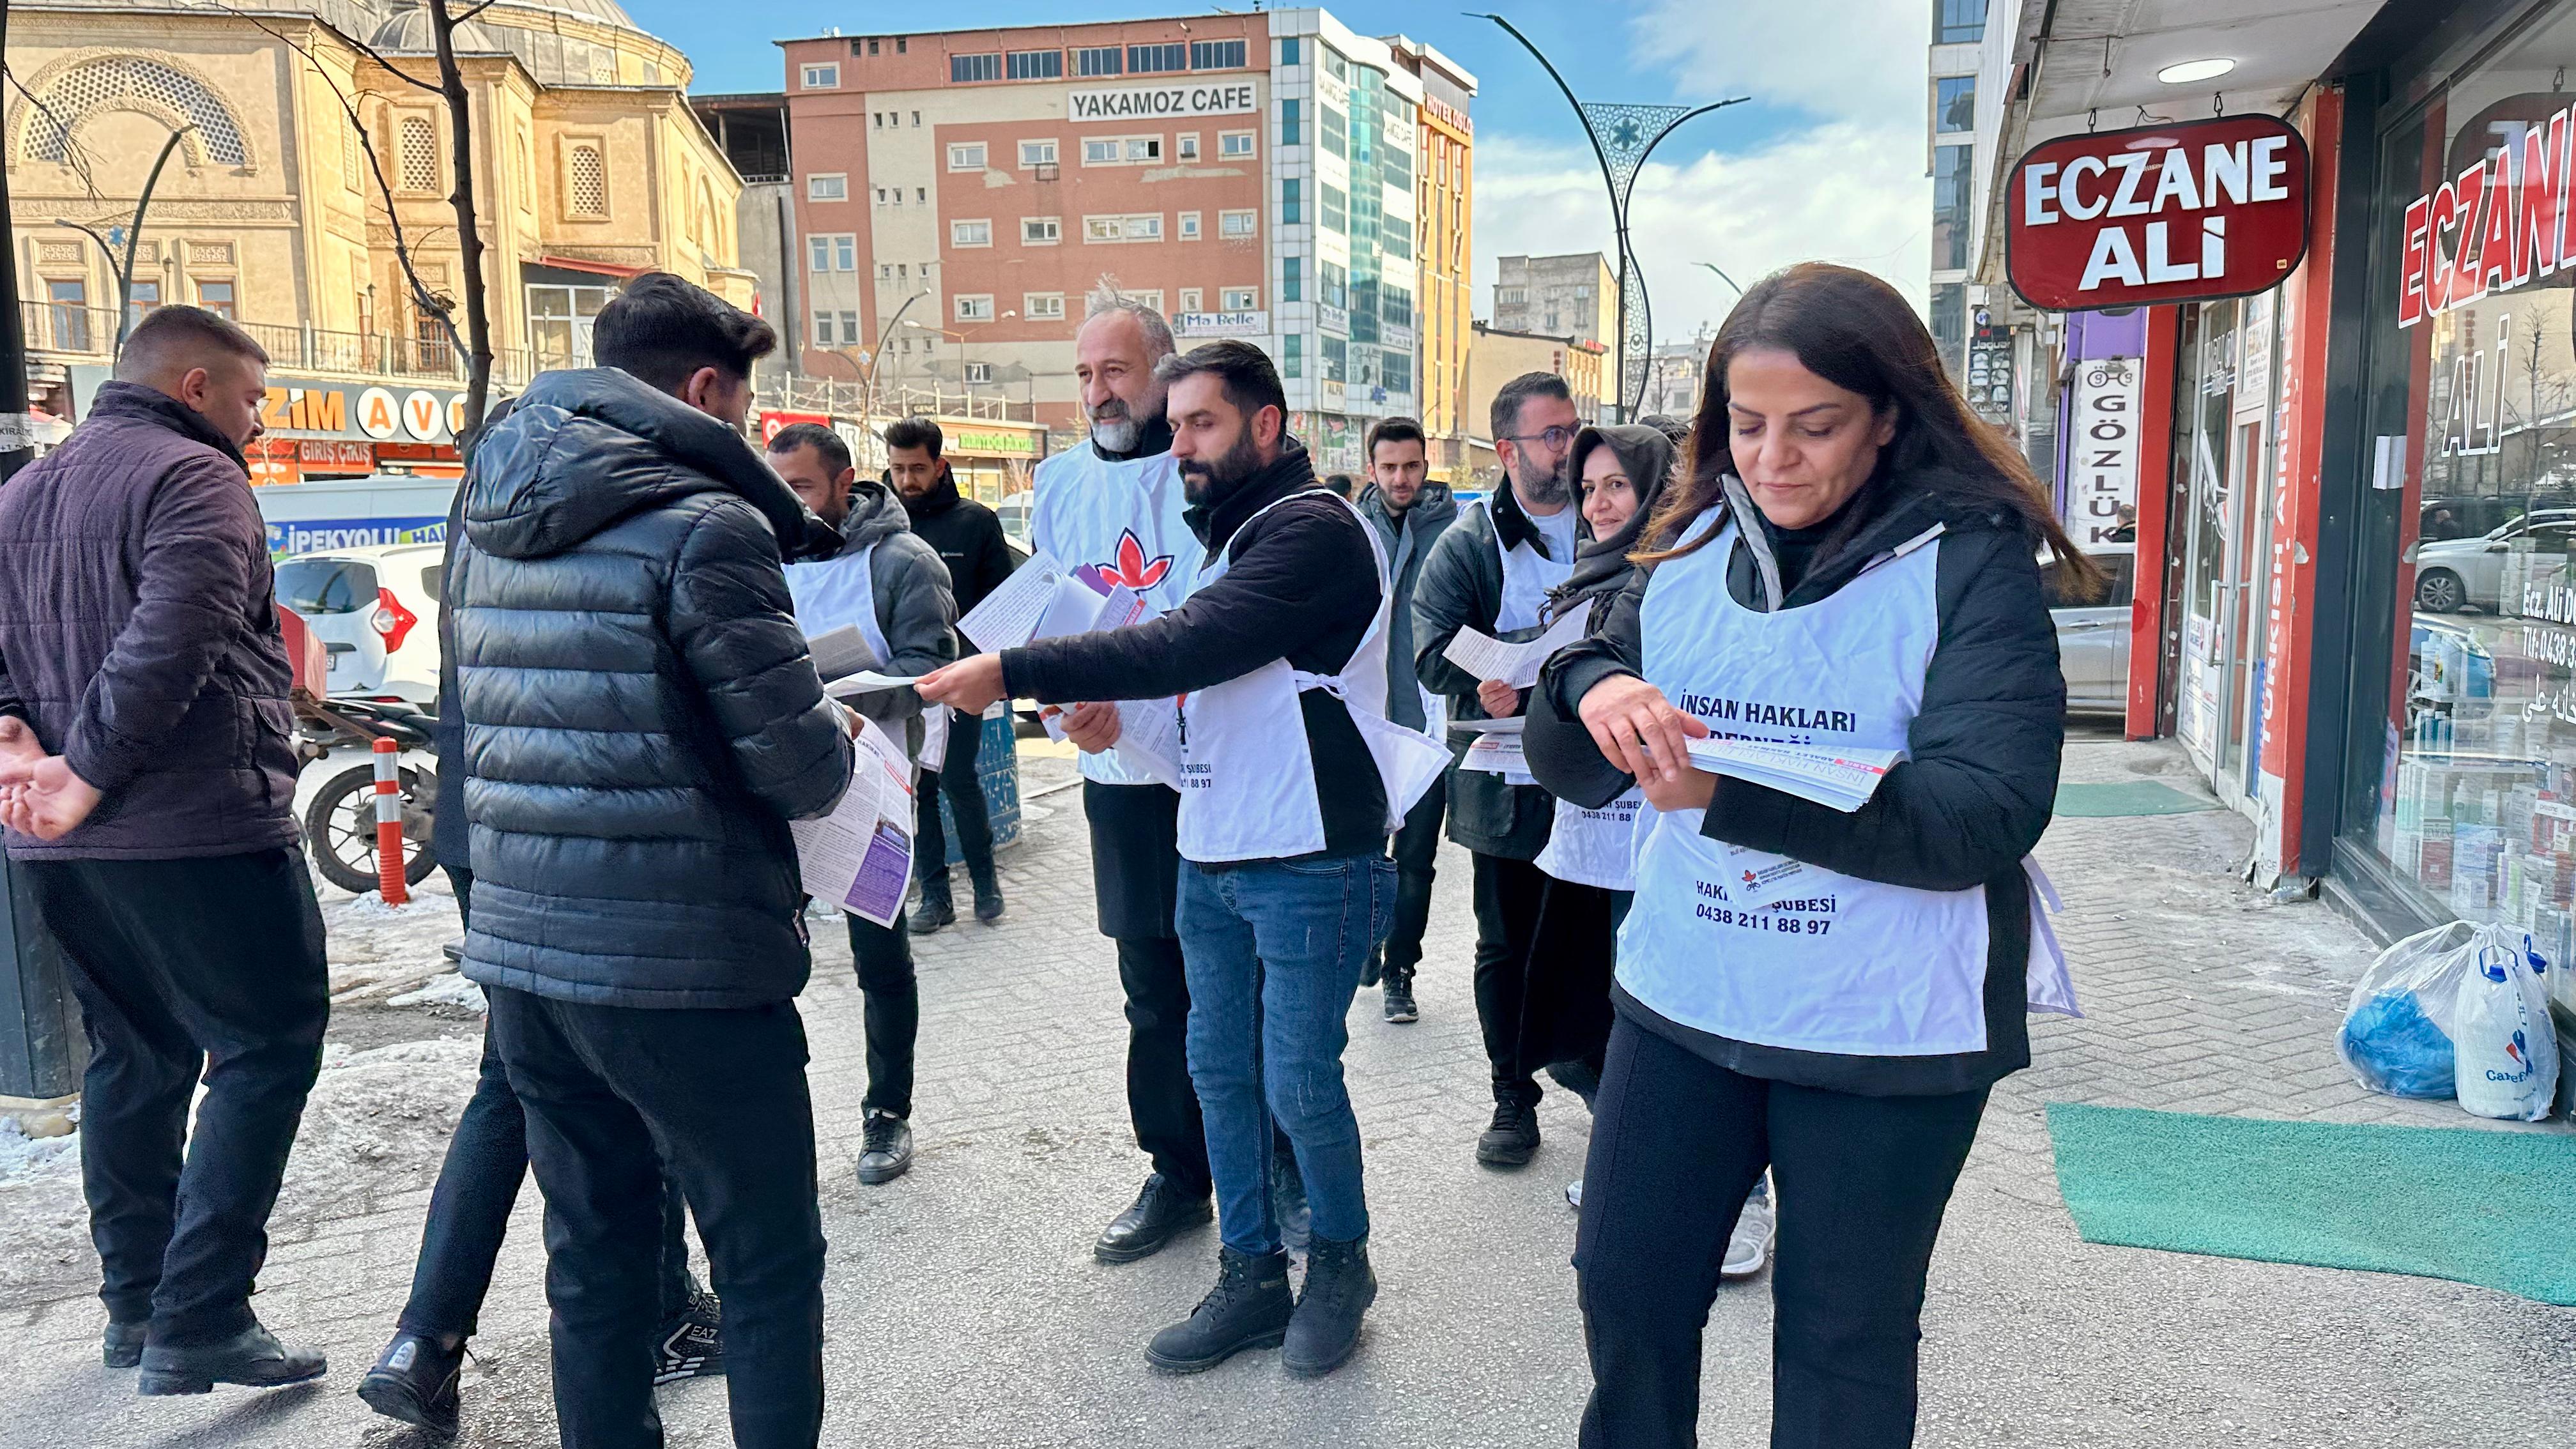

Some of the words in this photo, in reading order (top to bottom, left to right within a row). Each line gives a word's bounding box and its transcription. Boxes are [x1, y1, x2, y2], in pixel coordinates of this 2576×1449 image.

[1073, 91, 1184, 116] YAKAMOZ
[1192, 86, 1252, 111] CAFE
[1425, 93, 1452, 126] HOTEL
[2025, 135, 2288, 226] ECZANE
[2078, 215, 2225, 291] ALİ
[1186, 315, 1210, 326] Ma
[1216, 314, 1254, 325] Belle
[1972, 339, 2011, 351] Jaguar
[2441, 313, 2511, 458] ALİ
[2089, 395, 2126, 543] GÖZLÜK
[2260, 543, 2283, 746] TURKISH
[2275, 301, 2295, 526] AIRLINES
[2522, 582, 2543, 618] Ecz.
[2545, 585, 2563, 622] Ali
[2523, 625, 2539, 659] Tlf:
[2540, 629, 2567, 666] 0438
[1680, 689, 1740, 721] İNSAN
[1745, 702, 1855, 732] HAKLARI
[1191, 779, 1199, 788] 88
[1200, 779, 1211, 788] 97
[1602, 812, 1615, 821] 211
[1619, 813, 1631, 822] 88
[1696, 903, 1733, 924] 0438
[1738, 912, 1768, 930] 211
[1777, 918, 1801, 933] 88
[1807, 920, 1830, 935] 97
[1772, 894, 1836, 913] ŞUBESİ
[690, 1325, 719, 1339] EA7
